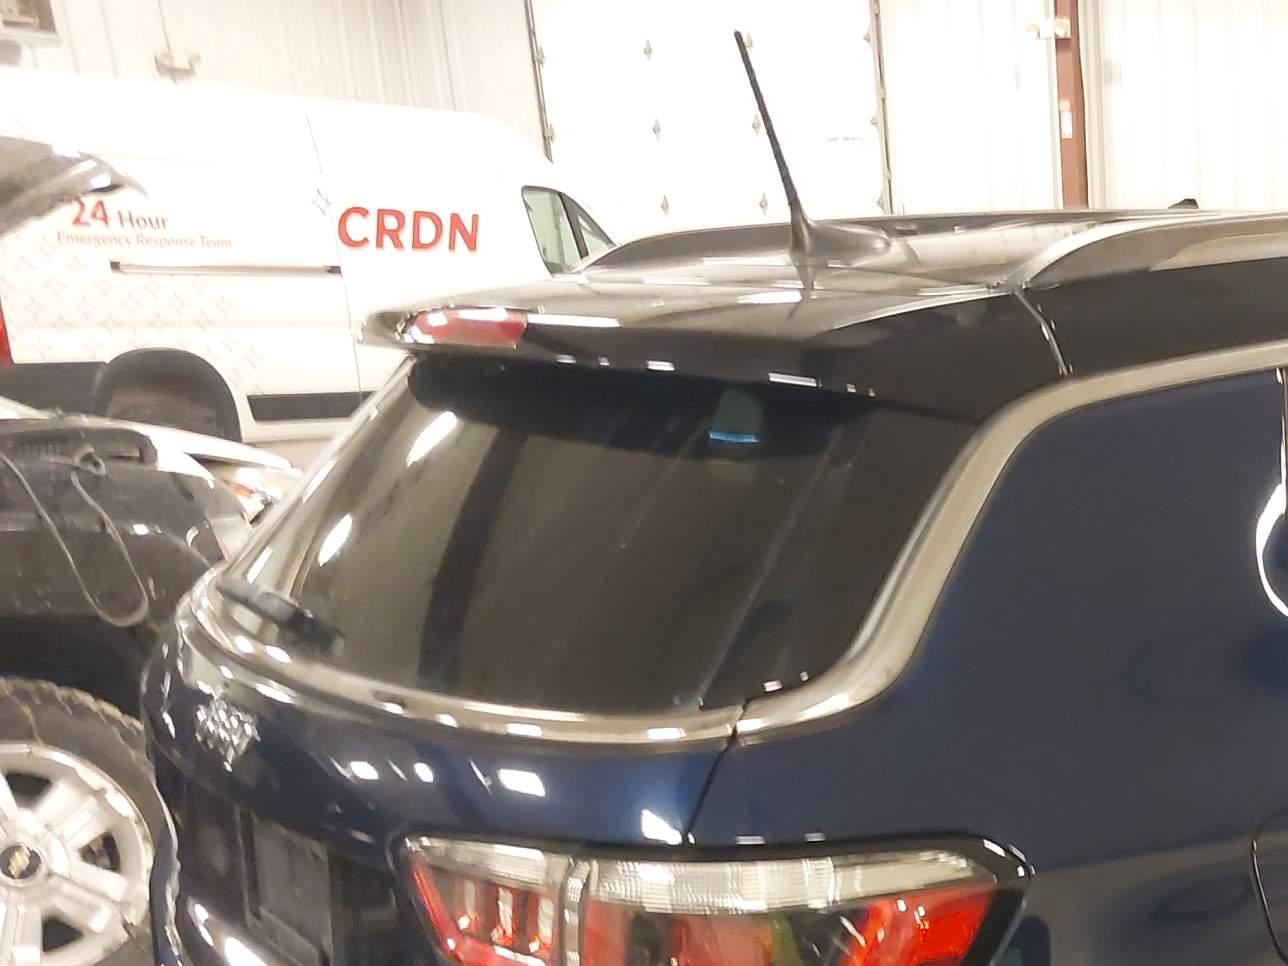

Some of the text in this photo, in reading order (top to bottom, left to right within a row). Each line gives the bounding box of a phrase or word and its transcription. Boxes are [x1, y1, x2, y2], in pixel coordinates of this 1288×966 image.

[117, 209, 169, 230] Hour
[338, 206, 480, 252] CRDN
[57, 231, 232, 249] Emergency Response Team
